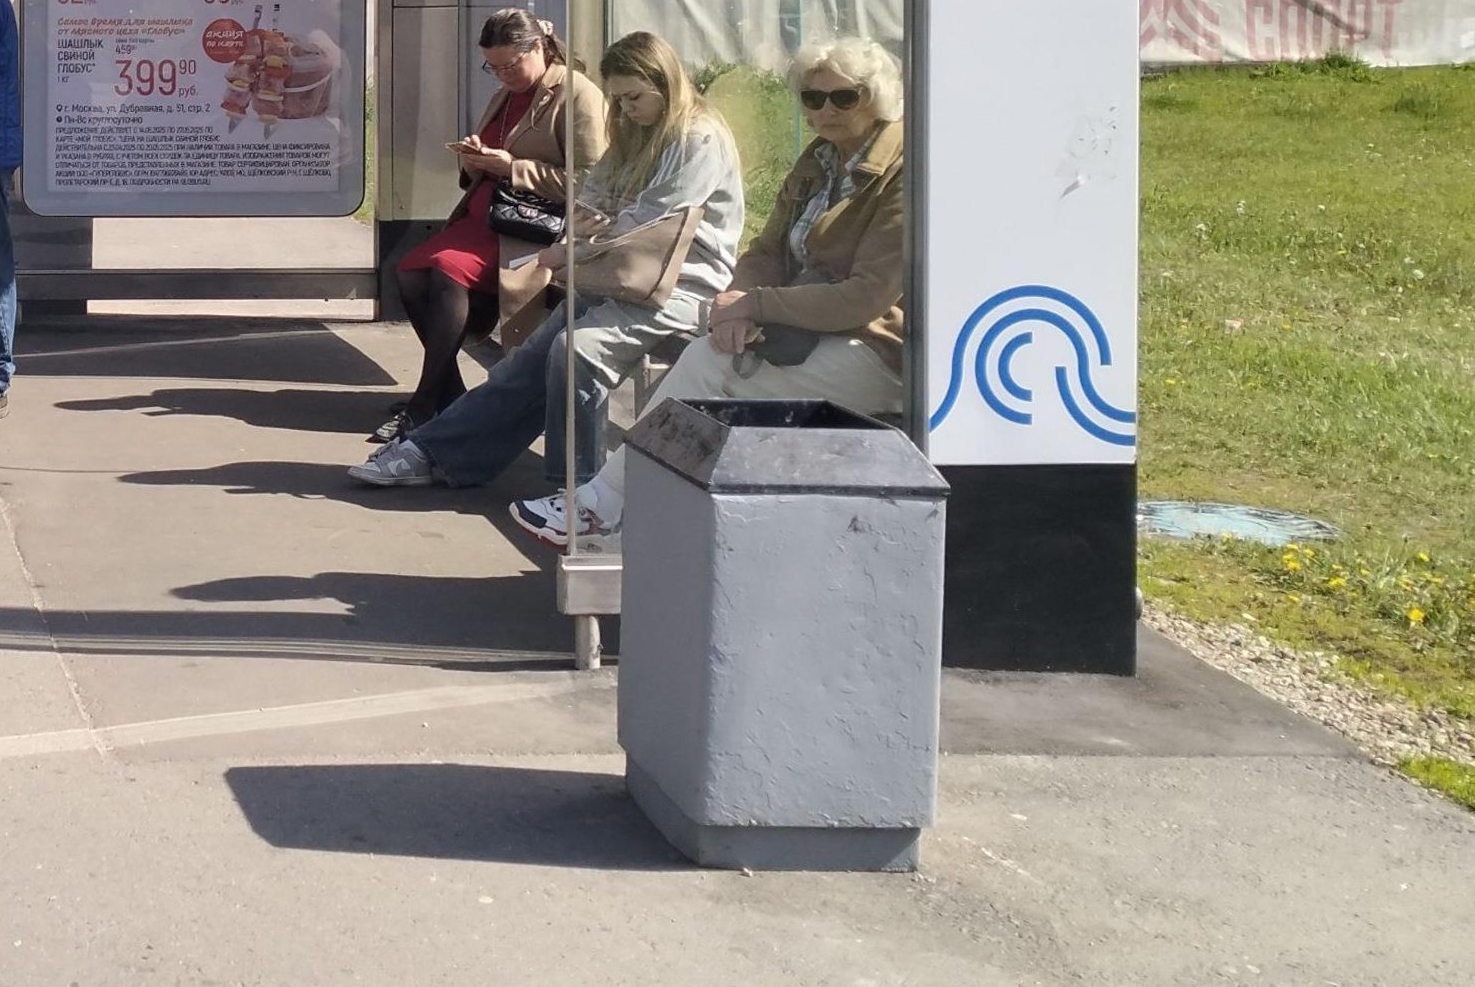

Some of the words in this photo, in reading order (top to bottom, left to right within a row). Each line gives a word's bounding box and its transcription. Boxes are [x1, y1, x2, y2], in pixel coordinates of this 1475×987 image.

[57, 39, 104, 49] ШАШЛЫК
[57, 49, 95, 61] СВИНОЙ
[114, 59, 177, 96] 399
[179, 59, 197, 75] 90
[179, 85, 198, 98] руб.
[119, 104, 165, 115] Дубравная,
[187, 106, 204, 115] стр.
[205, 104, 211, 113] 2
[64, 115, 87, 124] Пн-Вс
[88, 116, 143, 126] круглосуточно
